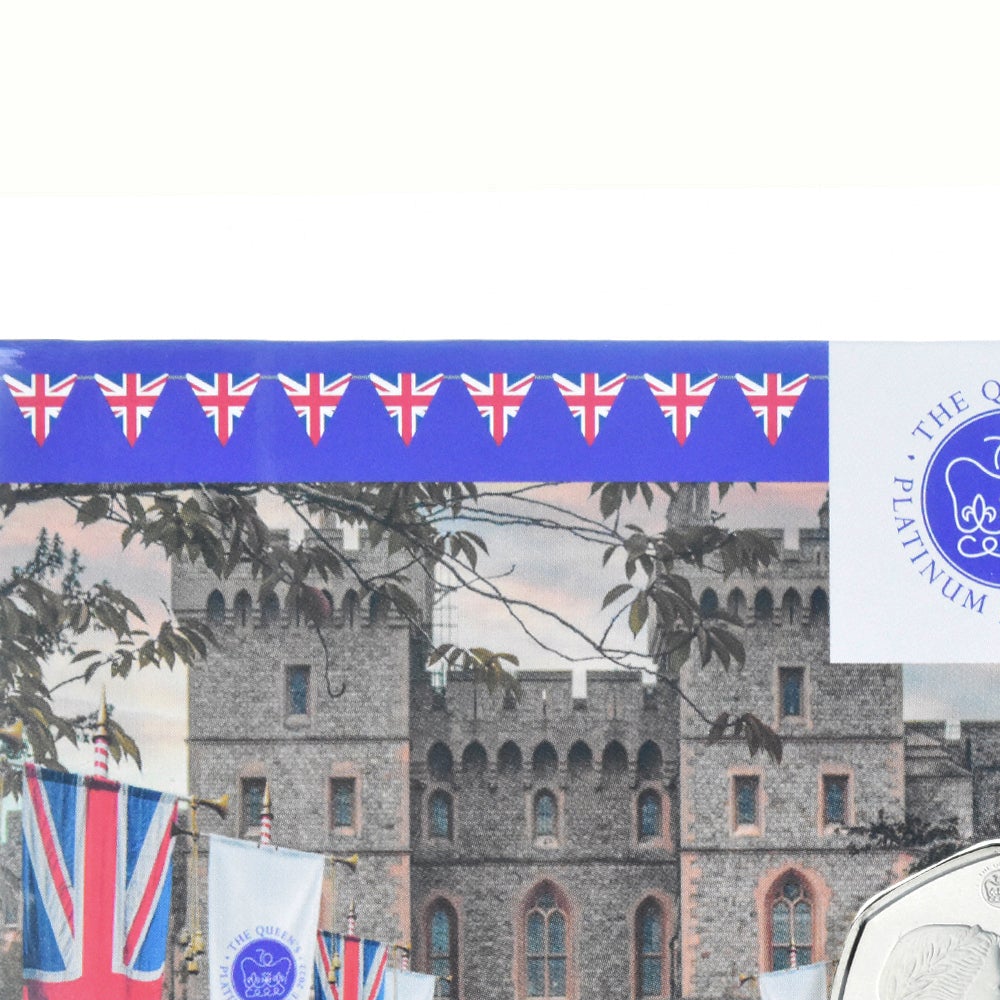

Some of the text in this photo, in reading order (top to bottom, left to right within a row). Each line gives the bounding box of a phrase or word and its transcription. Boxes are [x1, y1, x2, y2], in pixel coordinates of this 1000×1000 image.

[911, 390, 970, 442] THE
[892, 476, 989, 615] PLATINUM
[227, 929, 251, 951] THE
